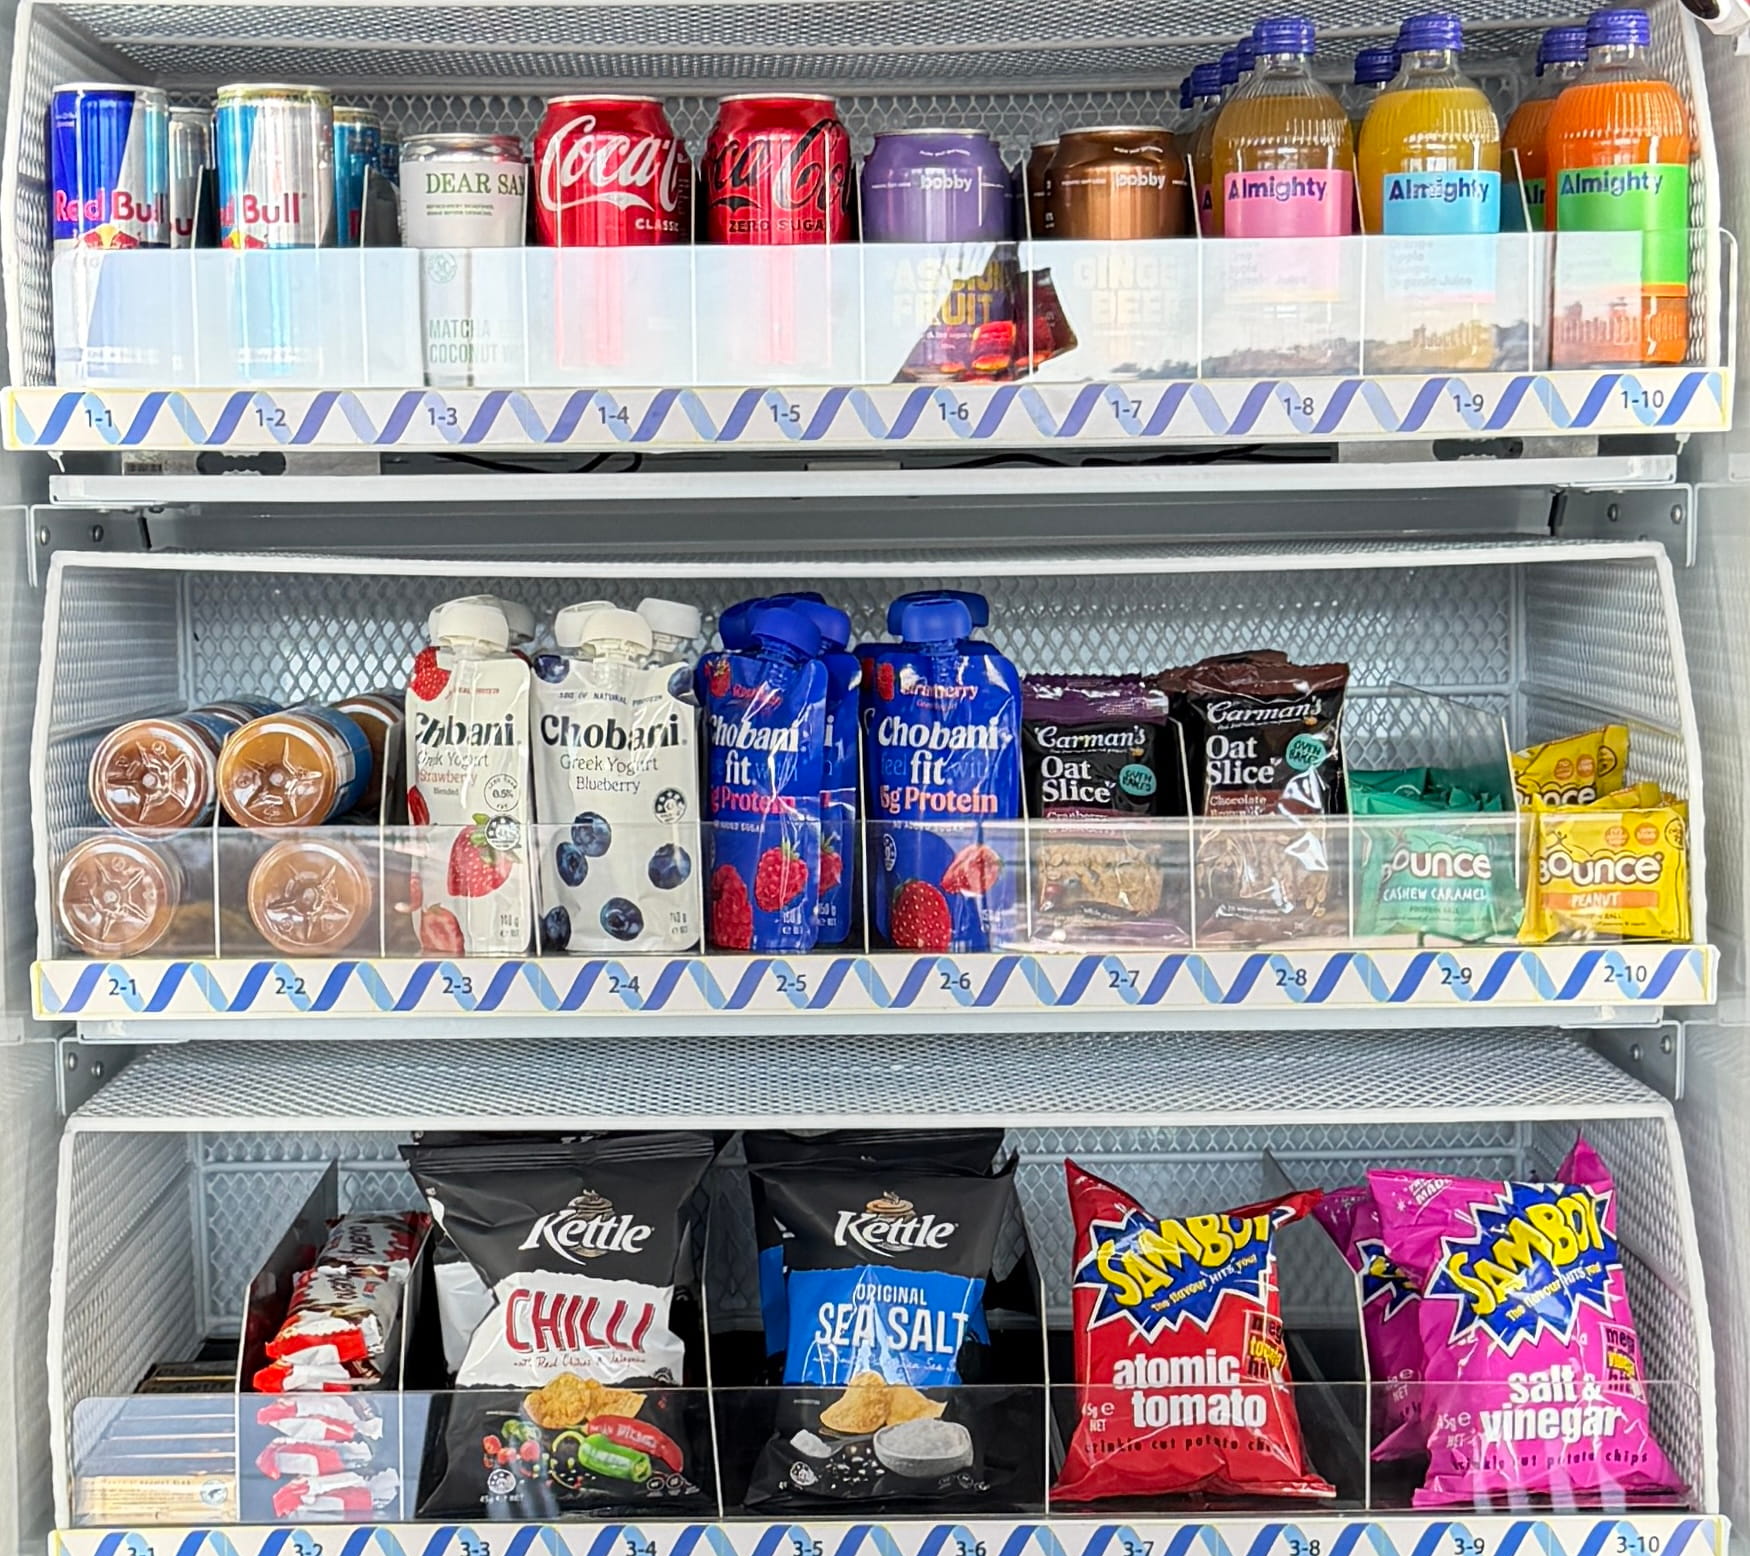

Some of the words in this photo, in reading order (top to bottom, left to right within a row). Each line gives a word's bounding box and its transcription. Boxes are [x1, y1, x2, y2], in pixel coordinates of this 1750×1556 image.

[426, 172, 492, 195] DEAR
[1228, 177, 1327, 201] Almighty
[1388, 178, 1490, 202] Almighty
[1560, 172, 1663, 198] Almighty
[55, 189, 106, 222] Red
[112, 191, 165, 223] Bull
[243, 192, 301, 225] Bull
[729, 218, 770, 233] ZERO
[779, 218, 826, 233] SUGA
[1111, 399, 1142, 419] 1-7
[1283, 397, 1315, 416] 1-8
[1453, 393, 1485, 413] 1-9
[1620, 389, 1665, 409] 1-10
[85, 407, 114, 428] 1-1
[255, 407, 287, 429] 1-2
[427, 406, 458, 426] 1-3
[598, 405, 630, 425] 1-4
[769, 404, 801, 423] 1-5
[938, 401, 970, 421] 1-6
[1206, 694, 1323, 724] Carman's
[540, 713, 679, 751] Chobani
[877, 715, 1000, 751] Chobani
[1034, 724, 1147, 749] Carman's
[1205, 734, 1259, 760] Oat
[559, 753, 603, 771] Greek
[1040, 754, 1093, 780] Oat
[1206, 759, 1276, 786] Slice
[576, 775, 641, 795] Blueberry
[1041, 777, 1112, 803] Slice
[904, 785, 998, 814] Protein
[1209, 793, 1267, 806] Chocolate
[1539, 849, 1662, 887] Bounce
[1383, 886, 1427, 902] CASHEW
[1430, 886, 1487, 901] CARAMEL
[1571, 891, 1622, 908] PEANUT
[776, 974, 807, 992] 2-5
[940, 972, 971, 990] 2-6
[1108, 970, 1140, 988] 2-7
[1275, 969, 1307, 986] 2-8
[1440, 967, 1473, 985] 2-9
[1603, 965, 1647, 983] 2-10
[108, 976, 137, 996] 2-1
[275, 976, 307, 995] 2-2
[442, 976, 473, 994] 2-3
[608, 976, 640, 994] 2-4
[517, 1210, 652, 1266] Kettle
[833, 1209, 956, 1258] Kettle
[1448, 1192, 1605, 1316] SAMBOY
[1208, 1266, 1235, 1287] HITS
[855, 1283, 928, 1306] ORIGINAL
[505, 1288, 656, 1353] CHILLI
[815, 1302, 876, 1348] SEA
[887, 1305, 969, 1355] SALT
[1112, 1348, 1240, 1389] atomic
[1508, 1364, 1578, 1405] salt
[1582, 1373, 1603, 1404] &
[1131, 1388, 1267, 1428] tomato
[1089, 1418, 1107, 1432] NET
[1479, 1402, 1622, 1444] vinegar
[1151, 1437, 1176, 1450] cut
[1605, 1448, 1649, 1465] chips
[1289, 1540, 1321, 1556] 3-8
[1454, 1538, 1486, 1555] 3-9
[1617, 1535, 1660, 1553] 3-10
